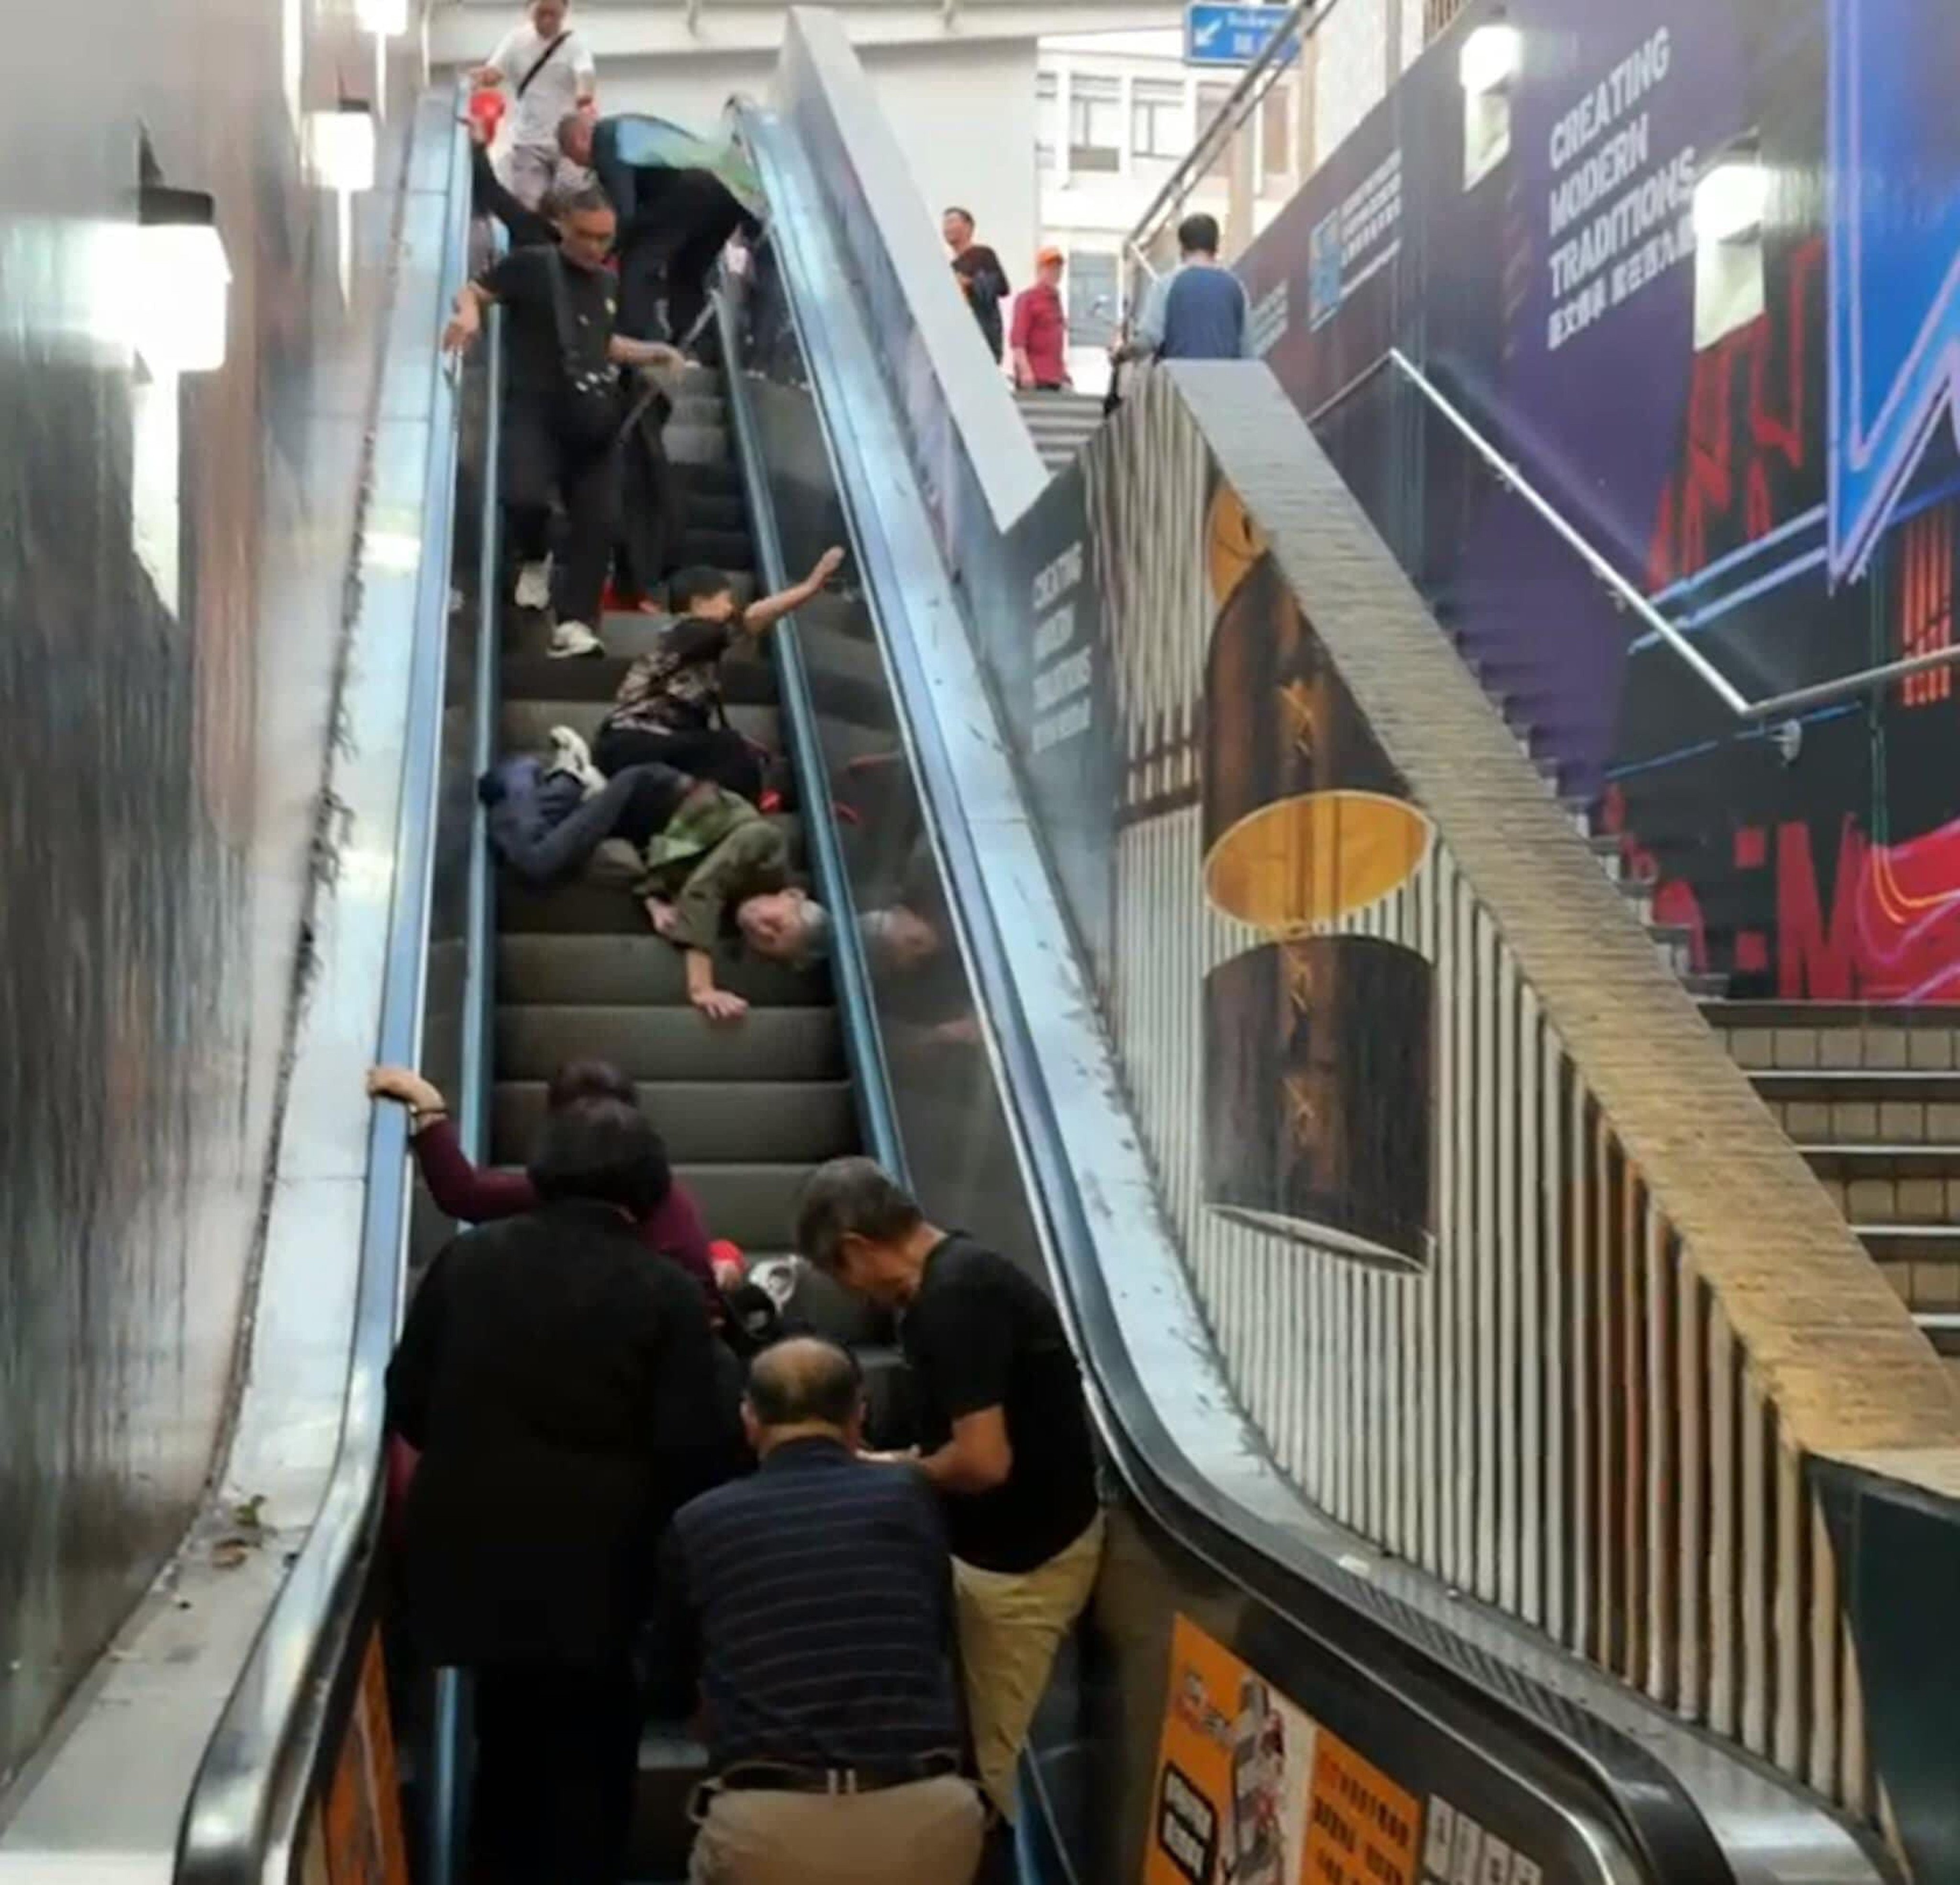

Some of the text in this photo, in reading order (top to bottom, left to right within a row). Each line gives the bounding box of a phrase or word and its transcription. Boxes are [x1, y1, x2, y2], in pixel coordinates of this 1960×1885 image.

[1550, 25, 1670, 171] CREATING
[1548, 146, 1697, 299] TRADITIONS
[1549, 112, 1649, 237] MODERN
